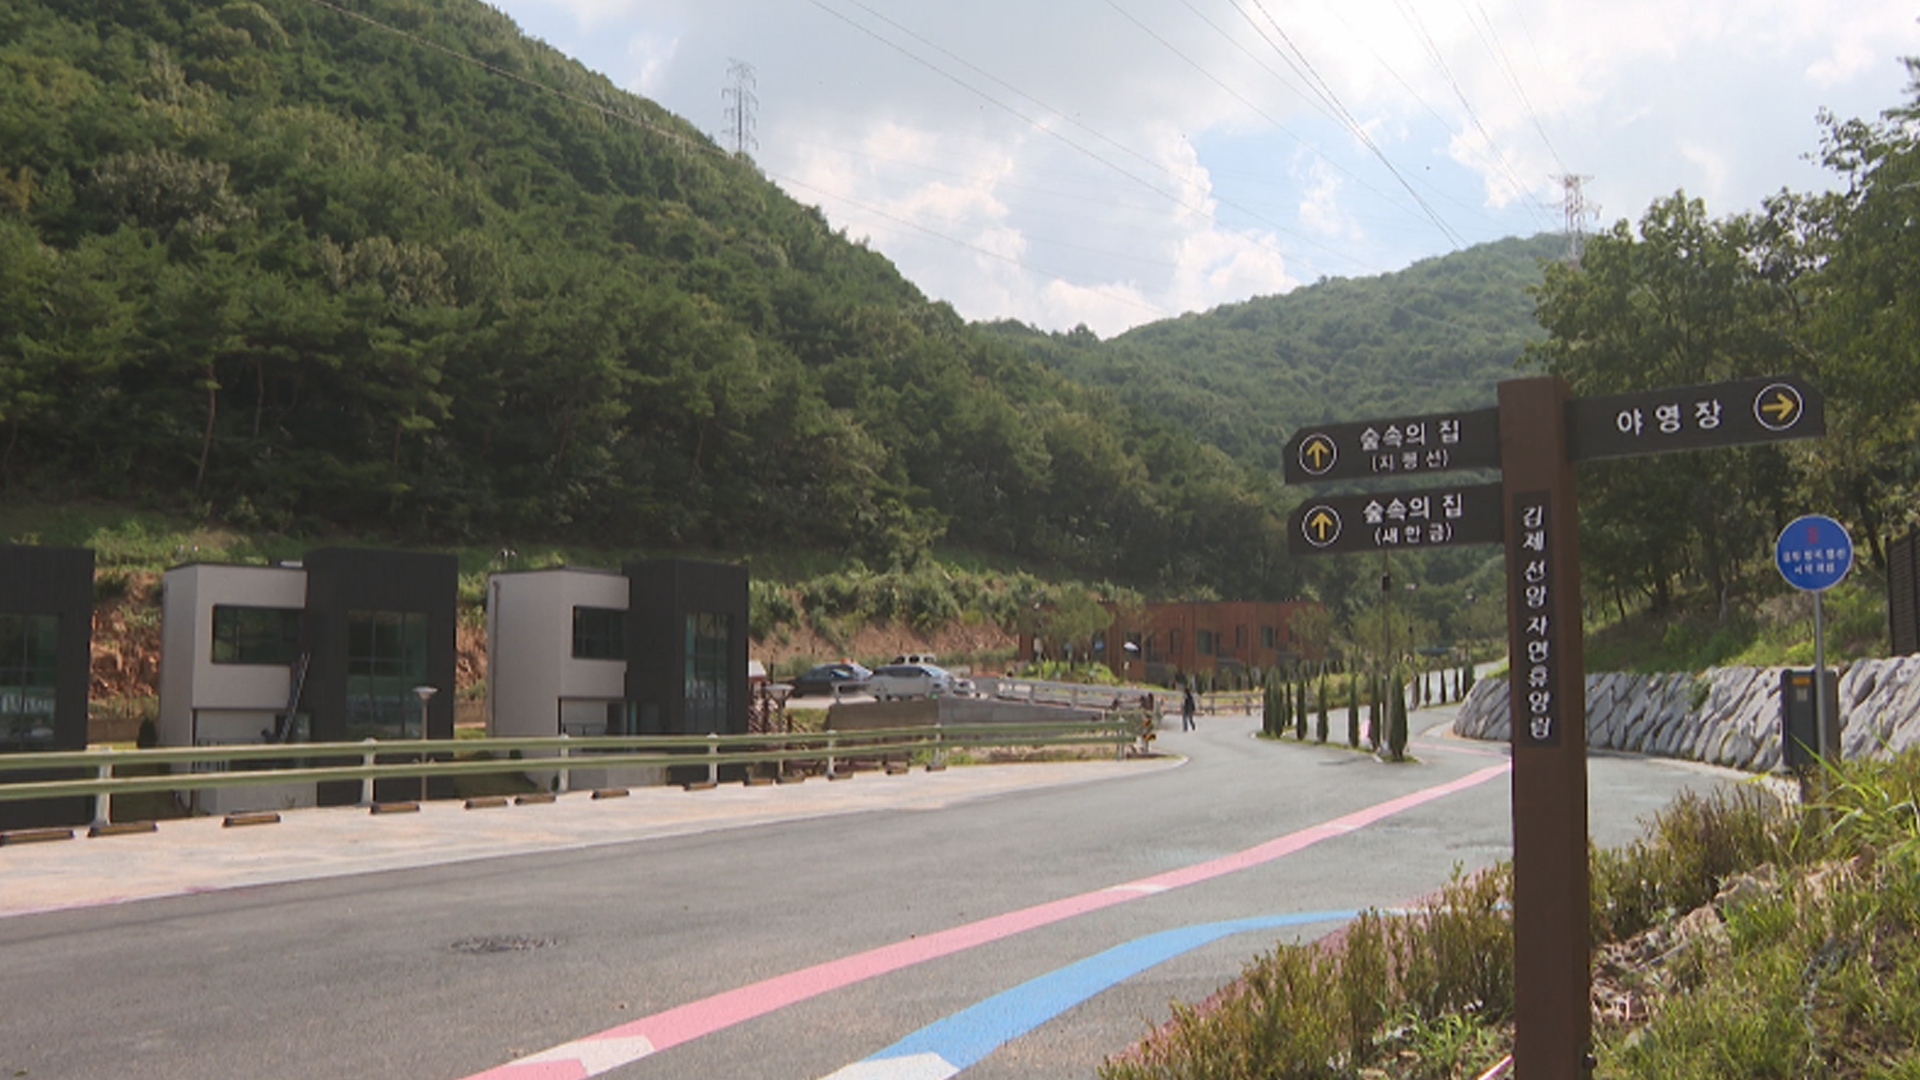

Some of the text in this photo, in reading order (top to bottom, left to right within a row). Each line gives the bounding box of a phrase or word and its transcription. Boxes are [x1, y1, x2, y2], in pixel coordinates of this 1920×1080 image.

[1360, 419, 1460, 451] 숲속의 집
[1616, 398, 1722, 436] 야영장
[1363, 493, 1462, 524] 숲속의 집
[1522, 505, 1545, 552] 김제
[1525, 560, 1547, 609] 선암
